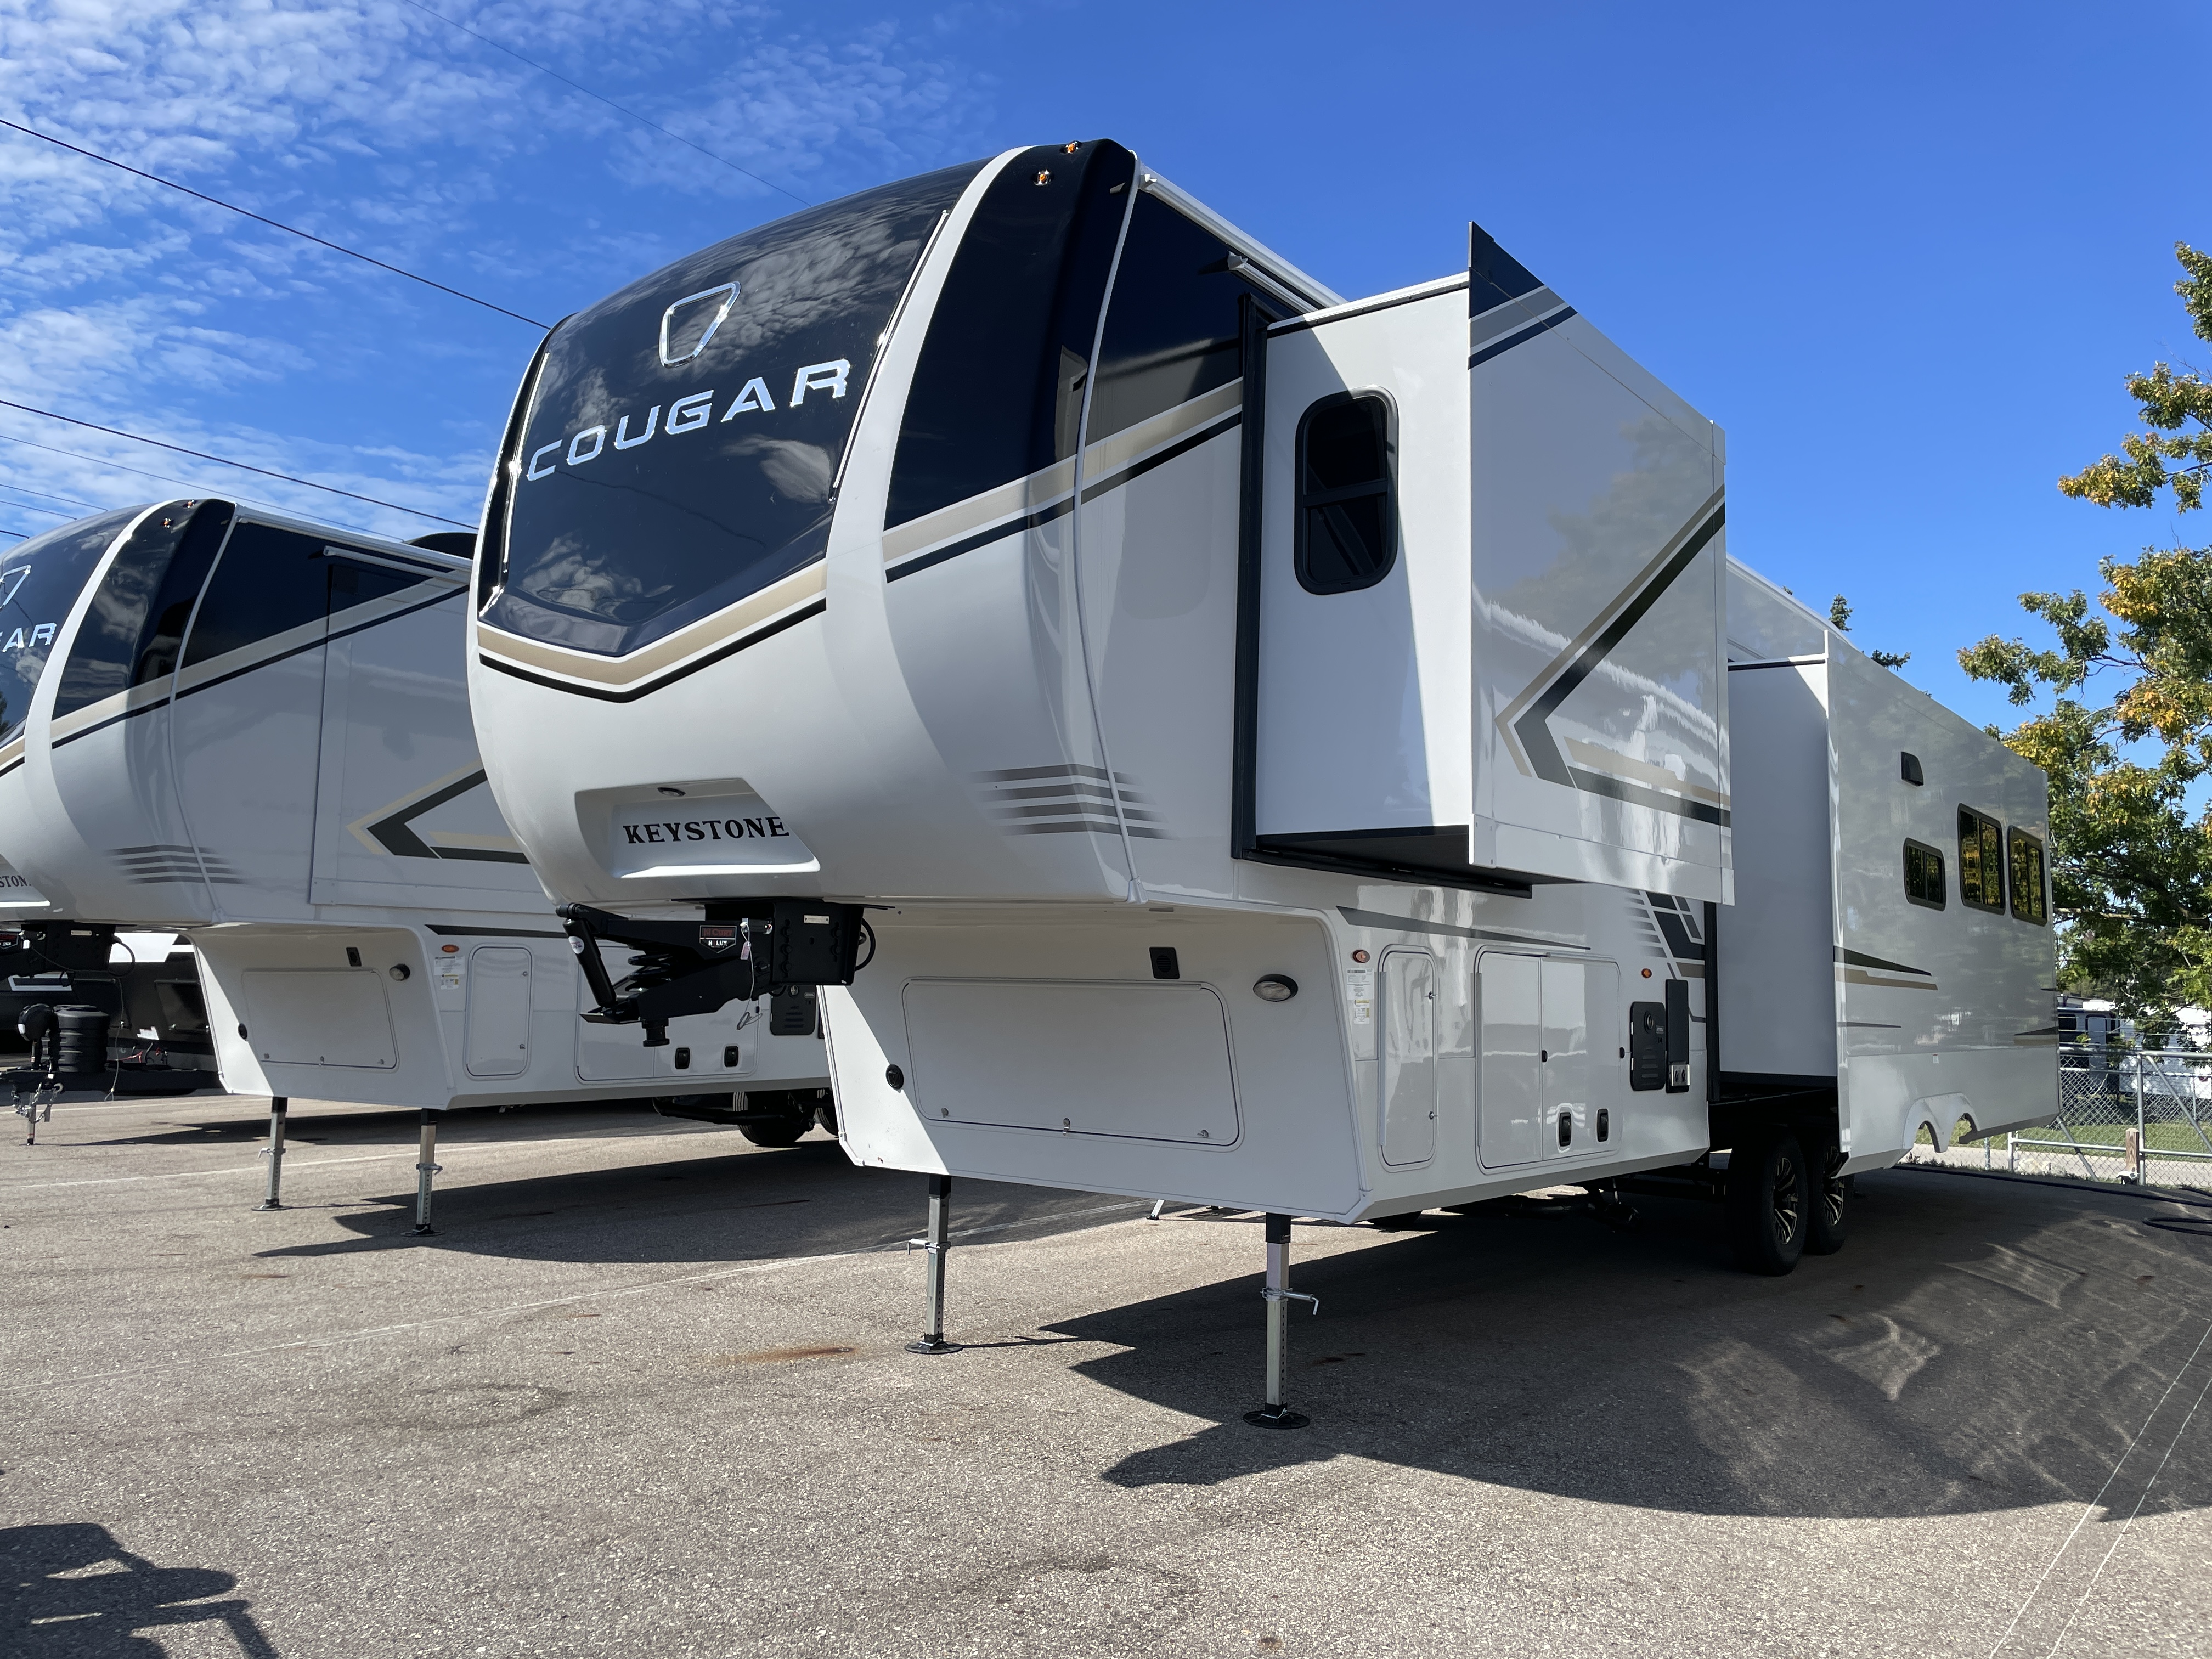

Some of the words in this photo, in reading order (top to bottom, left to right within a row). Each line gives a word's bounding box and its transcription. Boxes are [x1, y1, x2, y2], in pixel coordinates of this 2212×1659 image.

[526, 358, 850, 481] COUGAR
[0, 622, 57, 652] AR
[623, 816, 789, 844] KEYSTONE
